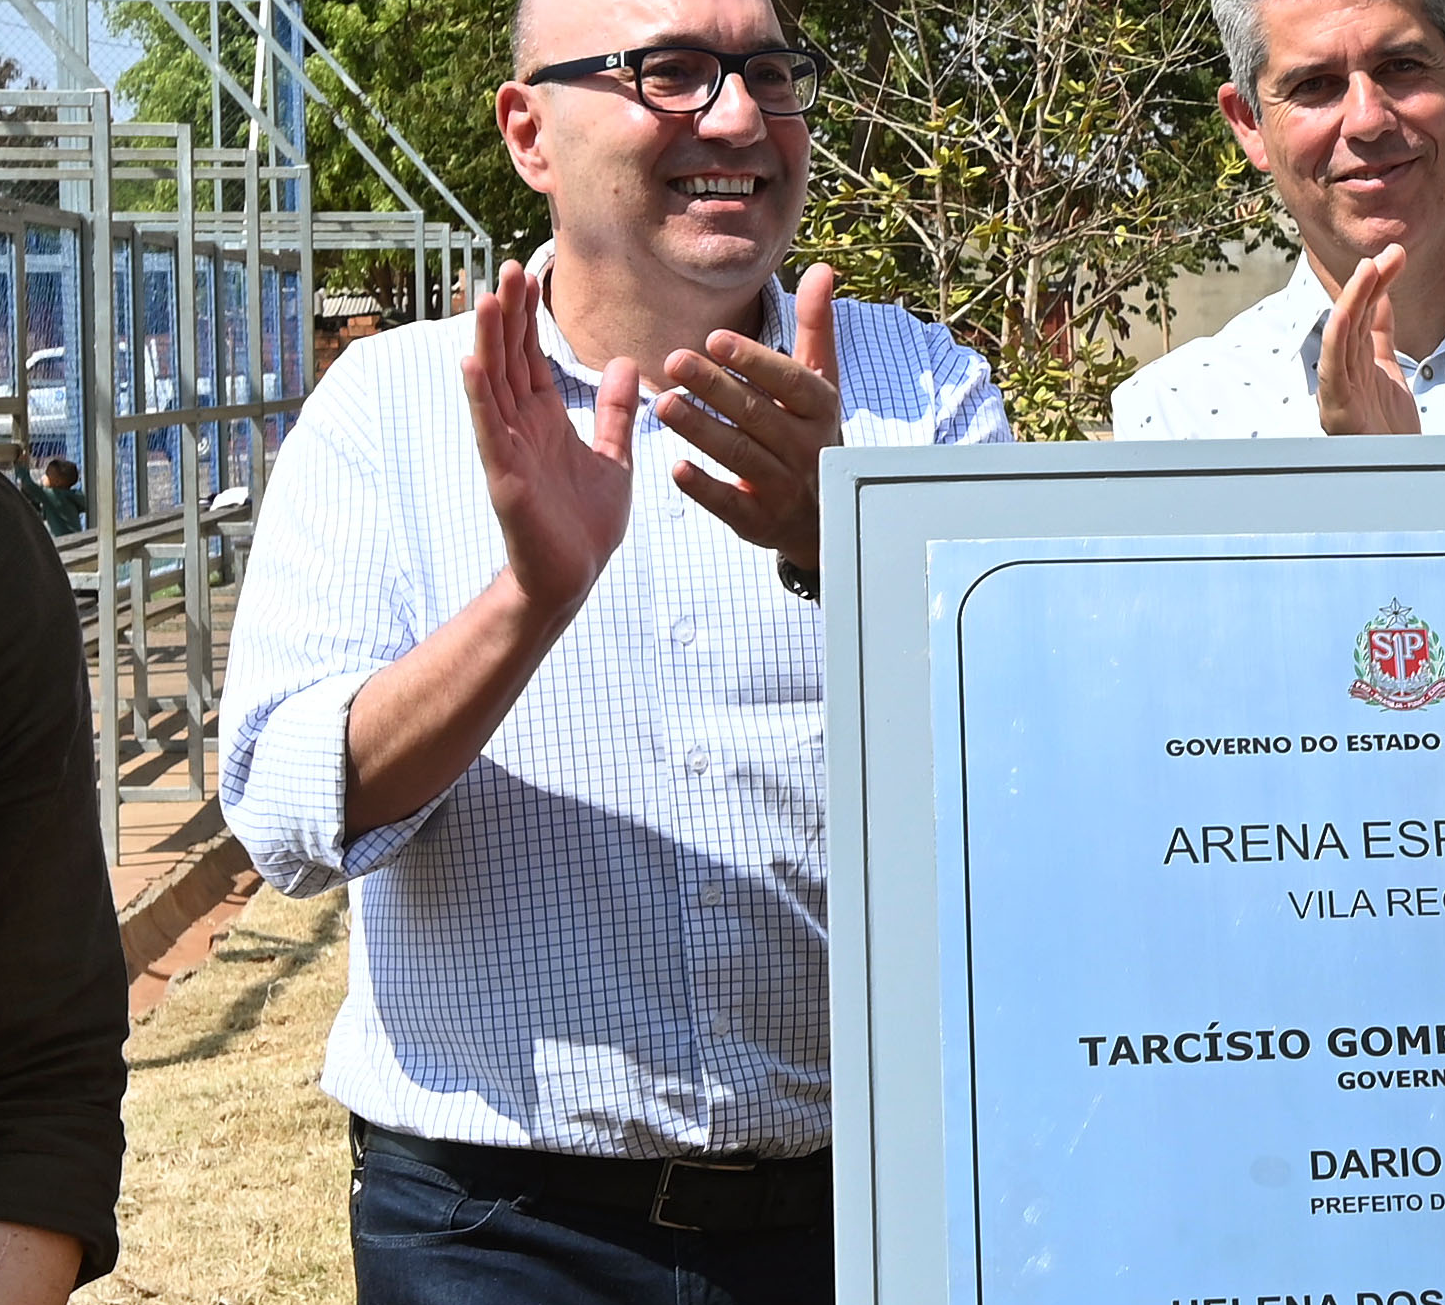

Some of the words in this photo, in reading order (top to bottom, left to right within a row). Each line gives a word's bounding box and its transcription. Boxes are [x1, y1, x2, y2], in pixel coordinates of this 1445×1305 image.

[1165, 736, 1292, 757] GOVERNO
[1300, 735, 1338, 754] DO
[1346, 733, 1441, 753] ESTADO
[1163, 822, 1349, 865] ARENA
[1288, 889, 1377, 920] VILA
[1078, 1021, 1311, 1067] TARCÍSIO
[1310, 1146, 1442, 1181] DARIO
[1310, 1194, 1423, 1215] PREFEITO
